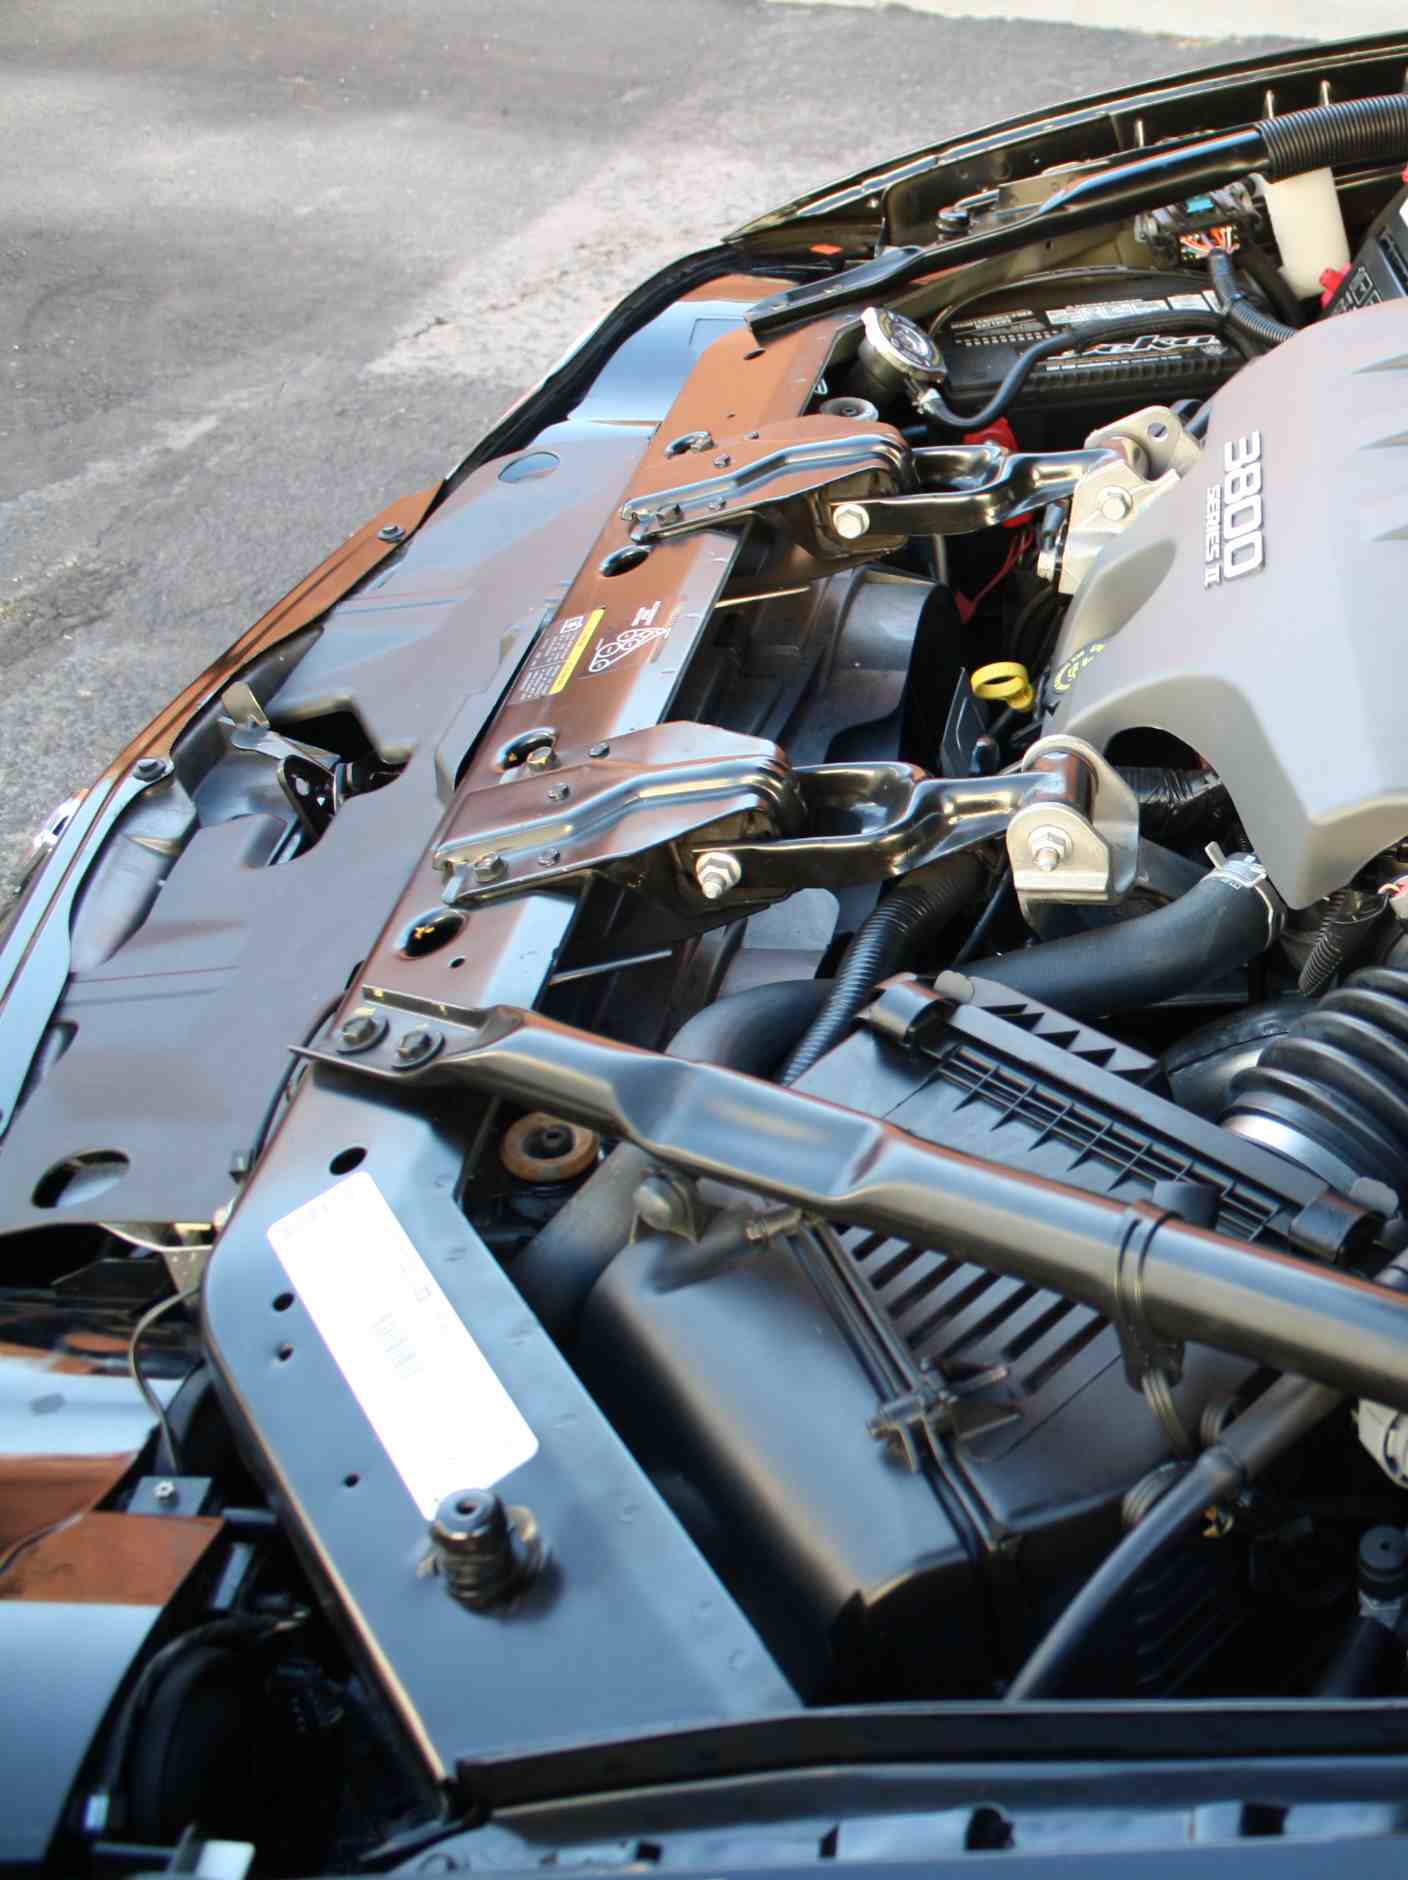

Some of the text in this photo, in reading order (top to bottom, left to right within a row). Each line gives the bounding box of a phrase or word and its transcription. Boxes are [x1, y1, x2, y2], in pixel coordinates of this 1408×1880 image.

[1204, 484, 1221, 588] SERIES II
[1223, 430, 1264, 578] 3800
